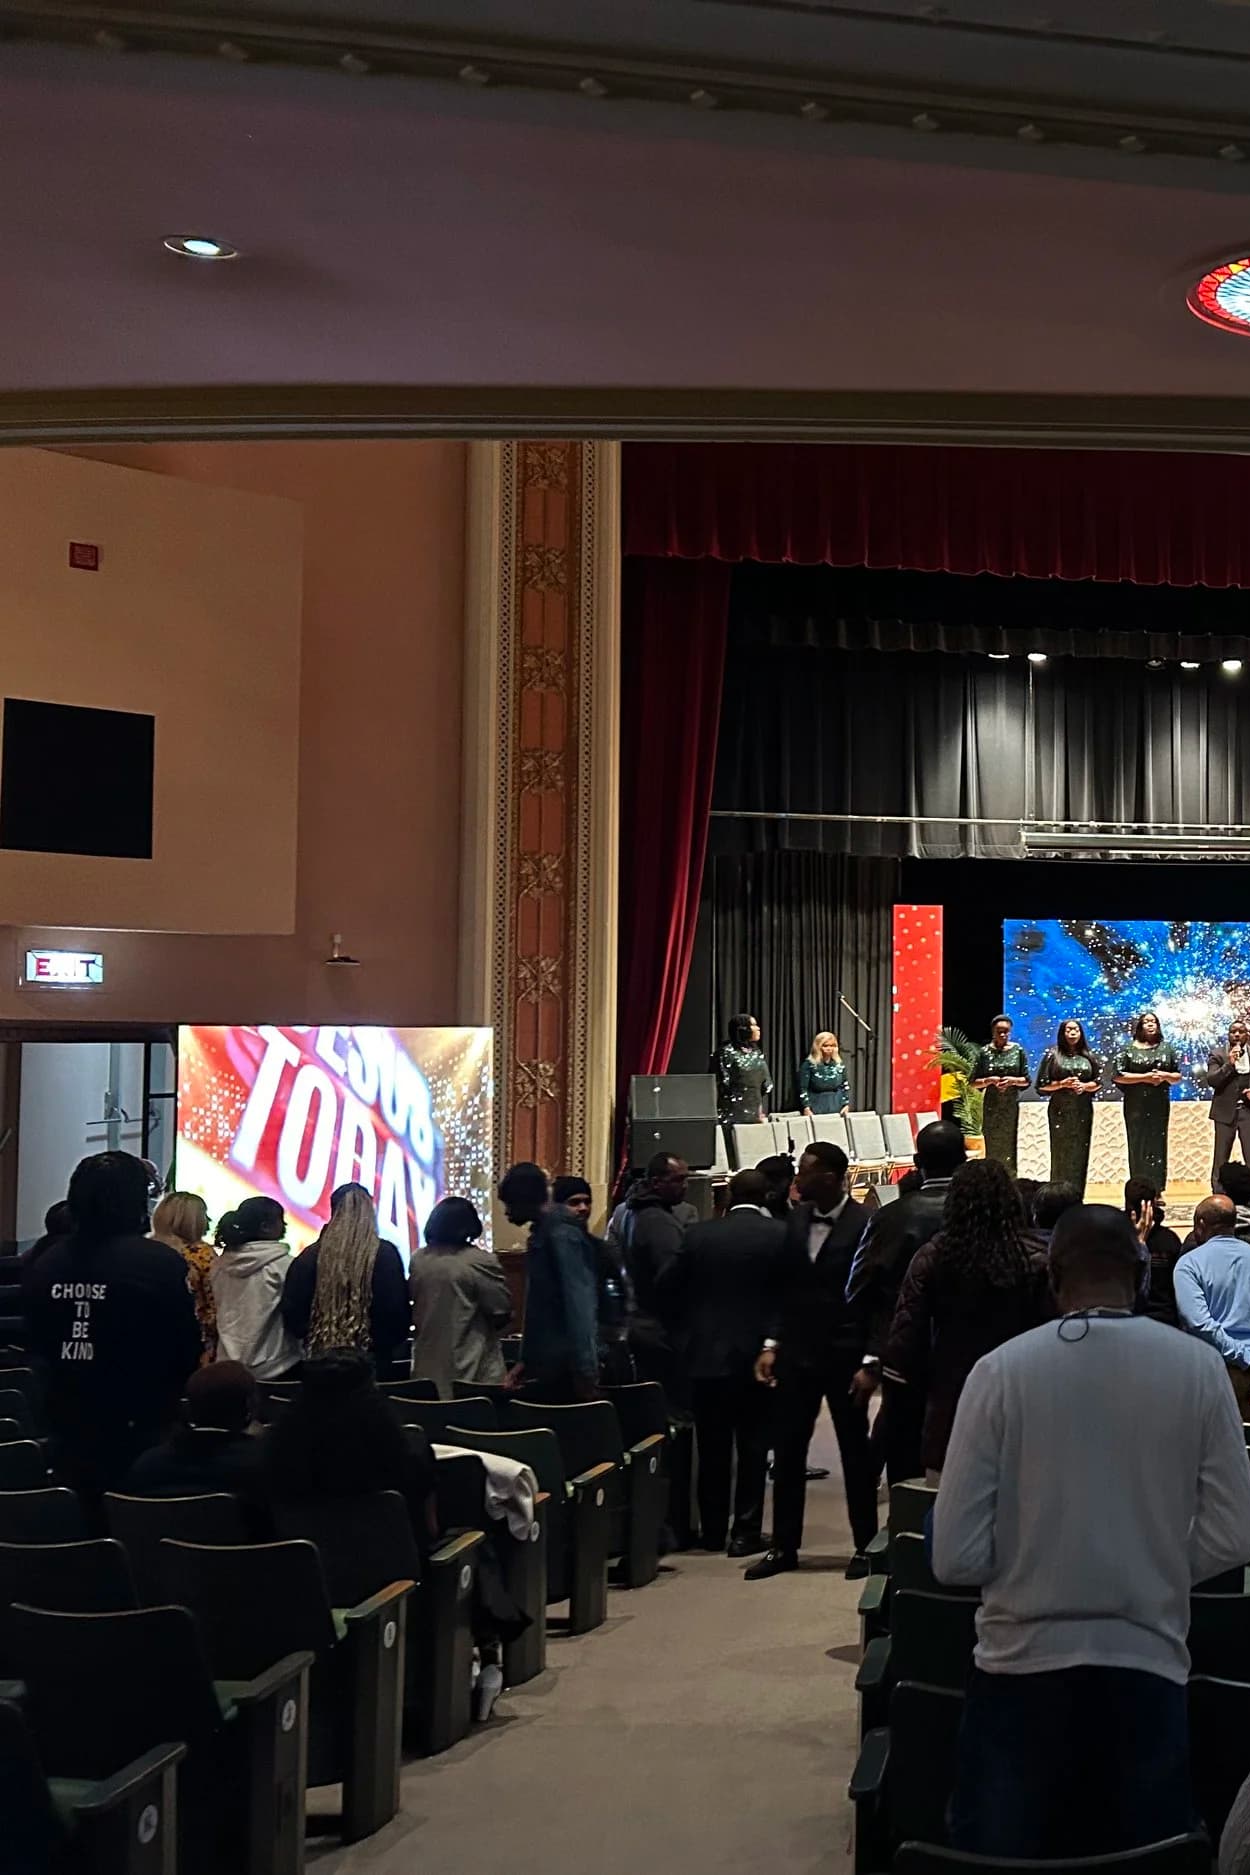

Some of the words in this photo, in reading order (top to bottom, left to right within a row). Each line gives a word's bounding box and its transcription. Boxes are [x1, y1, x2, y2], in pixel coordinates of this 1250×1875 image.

[51, 1283, 106, 1299] CHOOSE
[74, 1301, 90, 1318] TO
[72, 1321, 89, 1338] BE
[61, 1341, 94, 1360] KIND
